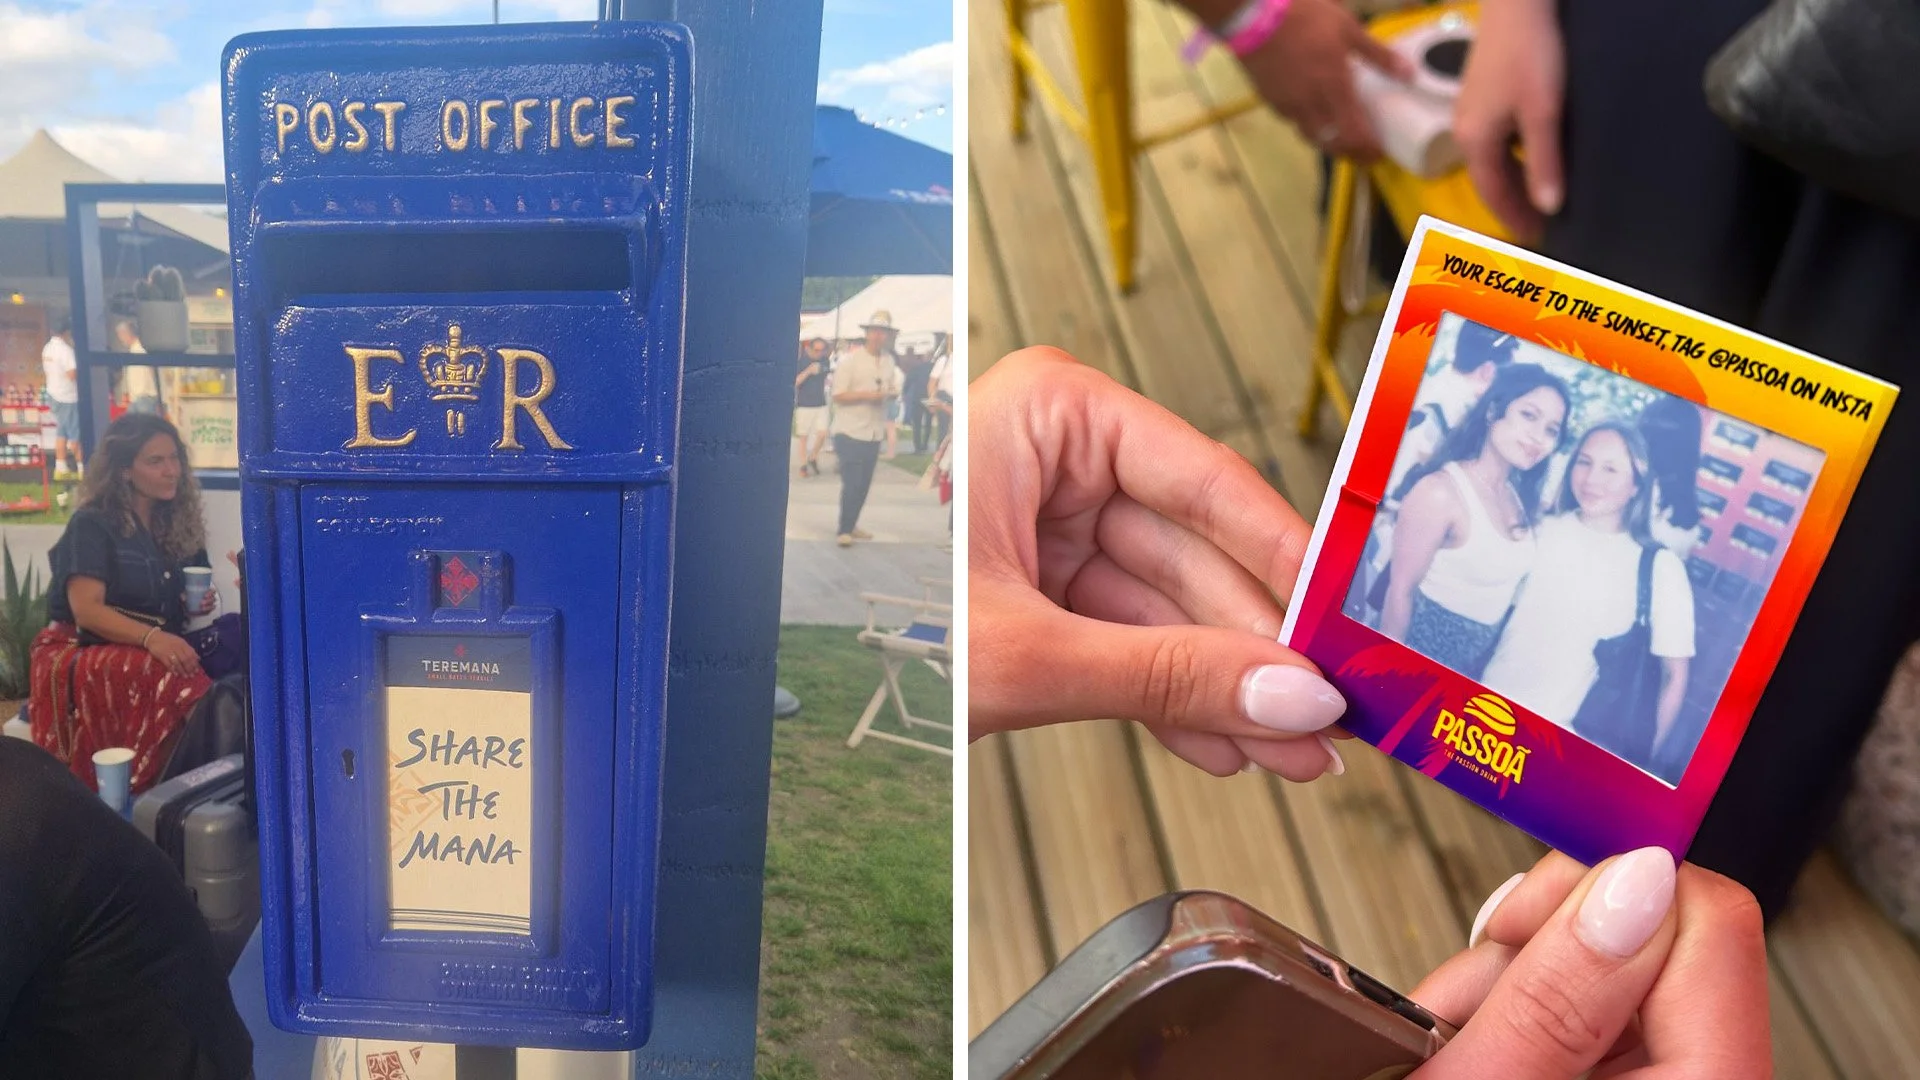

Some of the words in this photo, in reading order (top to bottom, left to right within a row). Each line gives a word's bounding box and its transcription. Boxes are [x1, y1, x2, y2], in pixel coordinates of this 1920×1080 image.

[276, 101, 406, 154] POST
[442, 96, 635, 151] OFFICE
[1443, 253, 1485, 283] YOUR
[1484, 270, 1545, 302] ESCAPE
[1545, 290, 1569, 311] TO
[1568, 298, 1604, 323] THE
[1602, 311, 1671, 351] SUNSET,
[1671, 334, 1707, 359] TAG
[1707, 349, 1790, 392] @PASSOA
[1790, 376, 1821, 401] ON
[1819, 387, 1874, 421] INSTA
[343, 346, 417, 450] E
[494, 347, 574, 450] R
[421, 659, 501, 676] TEREMANA
[395, 728, 526, 769] SHARE
[1431, 708, 1532, 784] PASSOÃ
[1444, 749, 1455, 760] THE
[1455, 755, 1480, 774] PASSION
[1480, 769, 1498, 785] DRINK
[418, 780, 500, 821] THE
[398, 830, 522, 869] MANA
